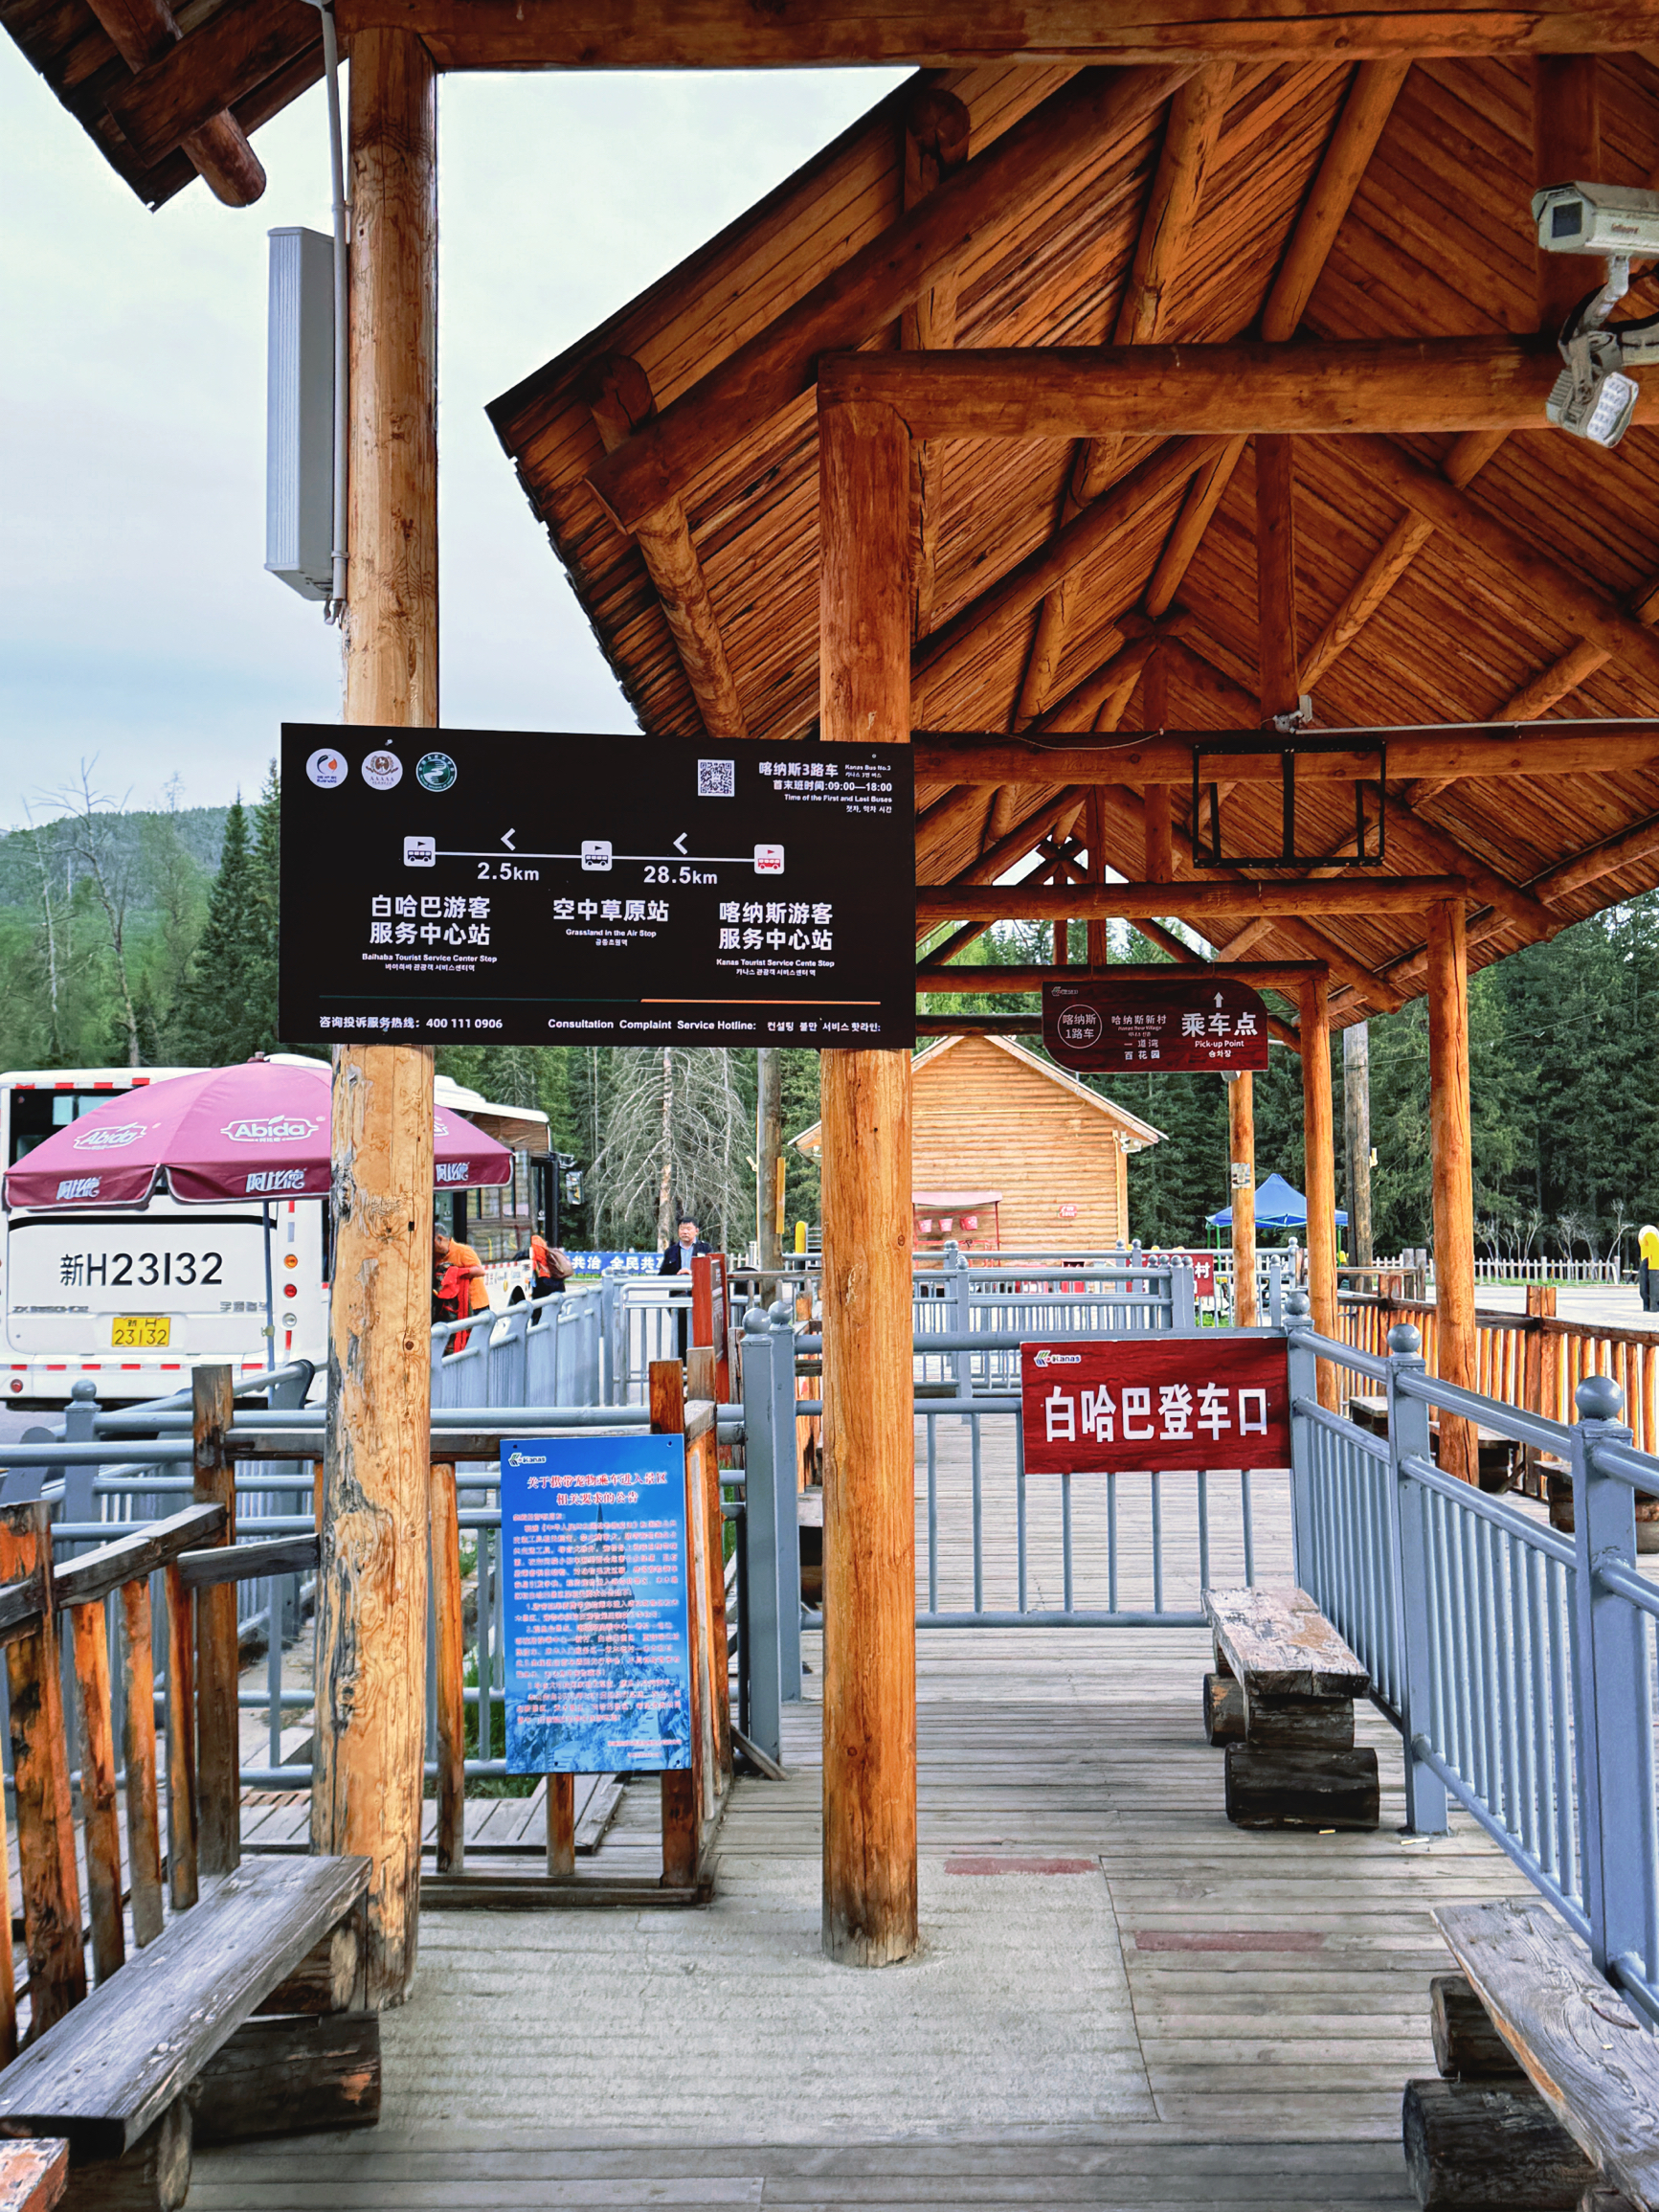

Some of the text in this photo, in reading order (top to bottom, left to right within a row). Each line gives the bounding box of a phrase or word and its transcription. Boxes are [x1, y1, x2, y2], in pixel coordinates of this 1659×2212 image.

[759, 761, 839, 778] 喀纳斯3路车
[477, 862, 540, 881] 2.5km
[643, 865, 718, 885] 28.5km
[371, 894, 491, 919] 白哈巴游客
[553, 897, 670, 922] 空中草原站
[719, 901, 833, 925] 喀纳斯游客
[370, 921, 491, 946] 服务中心站
[639, 930, 657, 938] Stop
[718, 927, 833, 951] 服务中心站
[818, 959, 835, 968] Stop
[426, 1018, 448, 1028] 400
[451, 1018, 472, 1029] 111
[474, 1019, 504, 1029] 0906
[548, 1019, 756, 1031] Consultation Complaint Service Hotline:
[822, 1022, 849, 1032] 서비스
[1063, 1014, 1097, 1026] 喀纳斯
[1181, 1011, 1259, 1038] 乘车点
[1065, 1028, 1094, 1040] 1路车
[1195, 1040, 1223, 1049] Pick-up
[235, 1121, 305, 1138] Abida
[59, 1252, 224, 1287] 新H23132
[114, 1328, 168, 1345] 23132
[1044, 1382, 1267, 1443] 白哈巴登车口
[555, 1490, 639, 1506] 相关要求的公告
